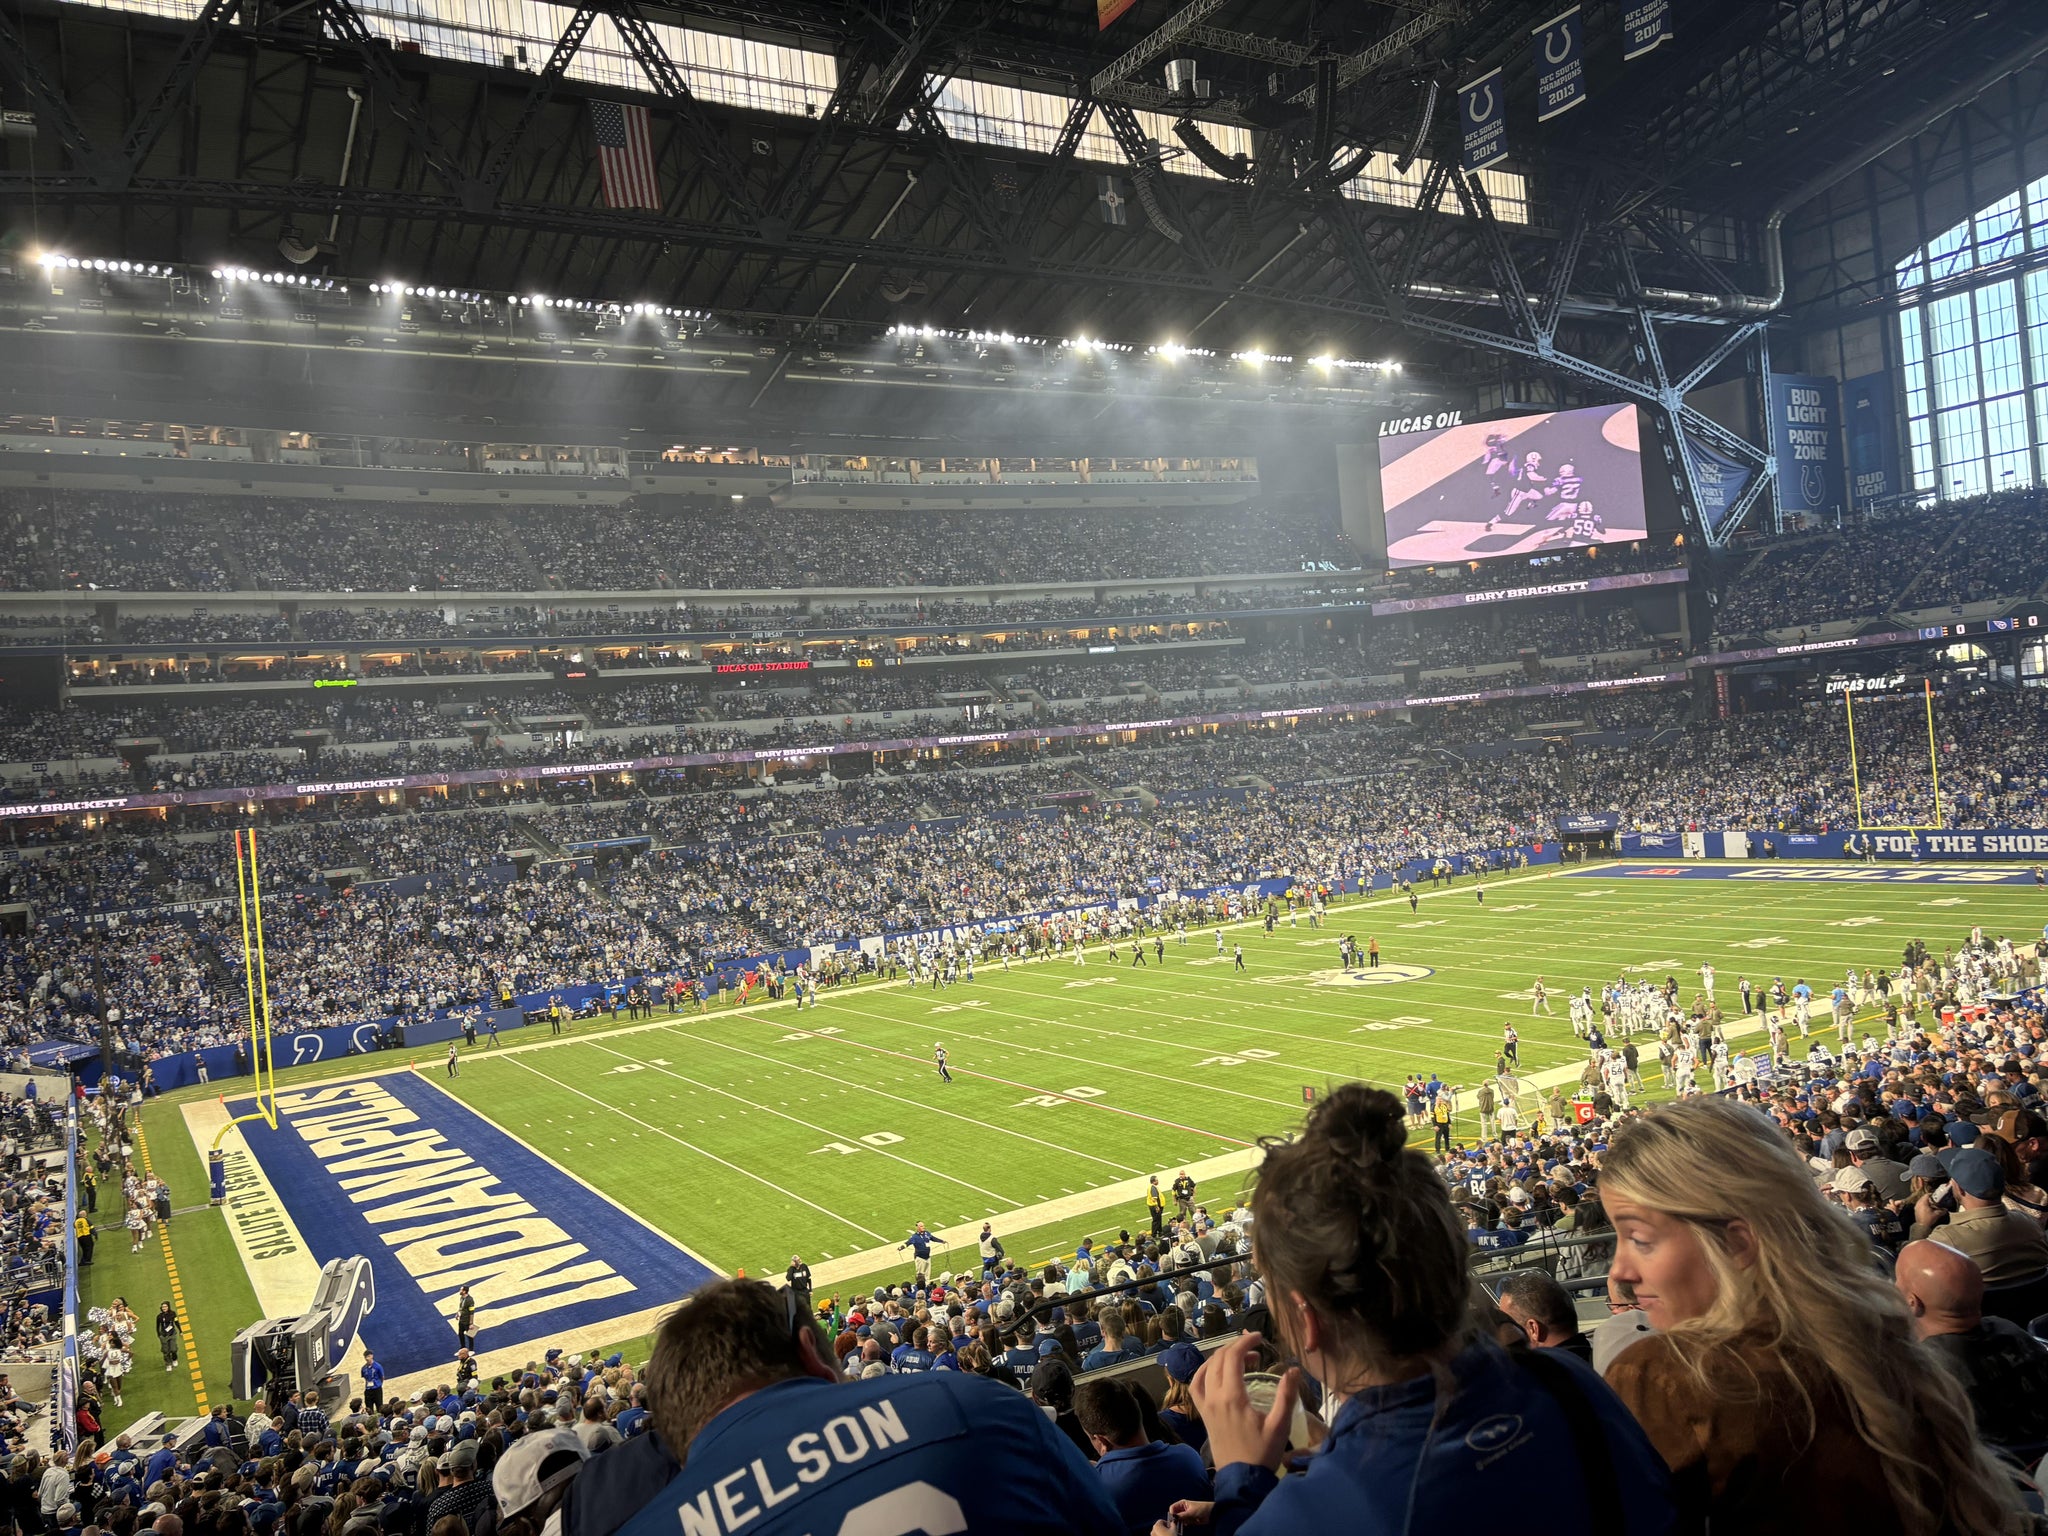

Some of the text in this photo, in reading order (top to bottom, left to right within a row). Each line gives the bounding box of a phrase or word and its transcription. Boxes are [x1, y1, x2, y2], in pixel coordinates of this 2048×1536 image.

[1624, 1, 1669, 32] CHAMPIONS
[1625, 9, 1641, 22] AFC
[1635, 19, 1661, 43] 2010
[1540, 59, 1580, 86] AFC SOUTH
[1539, 67, 1582, 95] CHAMPIONS
[1548, 84, 1575, 105] 2013
[1464, 119, 1502, 142] AFC SOUTH
[1464, 126, 1504, 151] CHAMPIONS
[1472, 142, 1497, 162] 2014
[1791, 389, 1821, 406] BUD
[1787, 406, 1827, 424] LIGHT
[1379, 411, 1463, 437] LUCAS OIL
[1788, 429, 1828, 445] PARTY
[1794, 445, 1827, 460] ZONE
[1856, 472, 1884, 486] BUD
[1855, 481, 1887, 497] LIGHT
[1573, 519, 1594, 536] 59
[1465, 581, 1589, 602] GARY BRACKETT
[1956, 616, 2038, 635] 0 0
[1777, 638, 1858, 654] GARY BRACKETT
[717, 661, 809, 673] LUCAS OIL STADIUM
[1587, 675, 1666, 688] GARY BRACKETT
[1826, 680, 1865, 694] LUCAS
[1866, 677, 1887, 689] OIL
[1405, 693, 1481, 706] GARY BRACKETT
[1261, 707, 1324, 718] GARY BRACKETT
[1105, 719, 1173, 731] GARY BRACKETT
[938, 732, 1009, 744] GARY BRACKETT
[754, 746, 835, 759] GARY BRACKETT
[541, 761, 634, 775] GARY BRACKETT
[297, 778, 405, 794] GARY BRACKETT
[40, 798, 128, 813] BRACKETT
[1926, 836, 1977, 852] THE
[1983, 835, 2048, 852] SHOE
[1728, 868, 2028, 882] COLTS
[1611, 1066, 1623, 1076] 64
[1580, 1106, 1591, 1118] G
[1470, 1180, 1486, 1195] 84
[229, 1190, 271, 1210] TO
[275, 1081, 638, 1335] INDIANAPOLIS
[235, 1207, 297, 1260] SALUTE
[678, 1399, 909, 1536] NELSON
